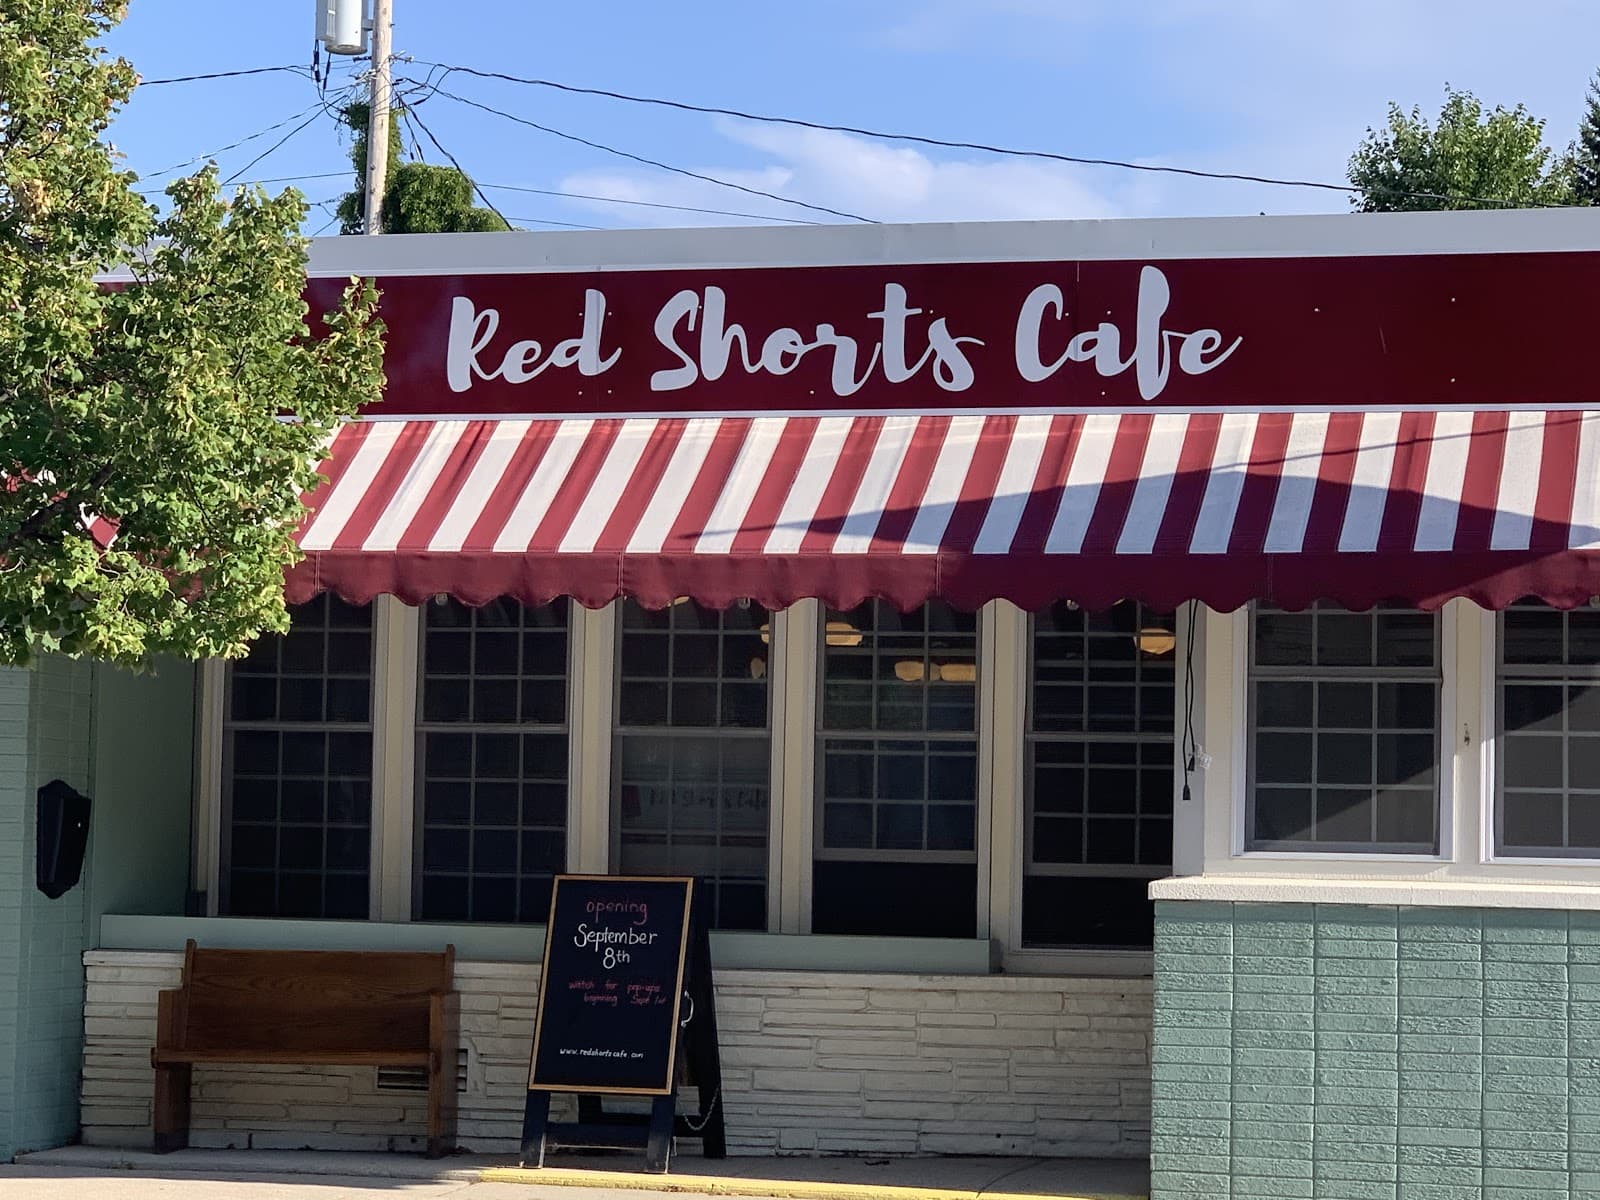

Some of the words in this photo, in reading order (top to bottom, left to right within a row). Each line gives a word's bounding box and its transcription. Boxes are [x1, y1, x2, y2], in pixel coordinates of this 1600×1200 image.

[447, 288, 622, 393] Red
[651, 283, 984, 397] Shorts
[1016, 266, 1243, 400] Cafe
[586, 900, 648, 925] opening
[574, 923, 658, 952] September
[603, 947, 630, 969] 8th
[605, 979, 618, 990] for
